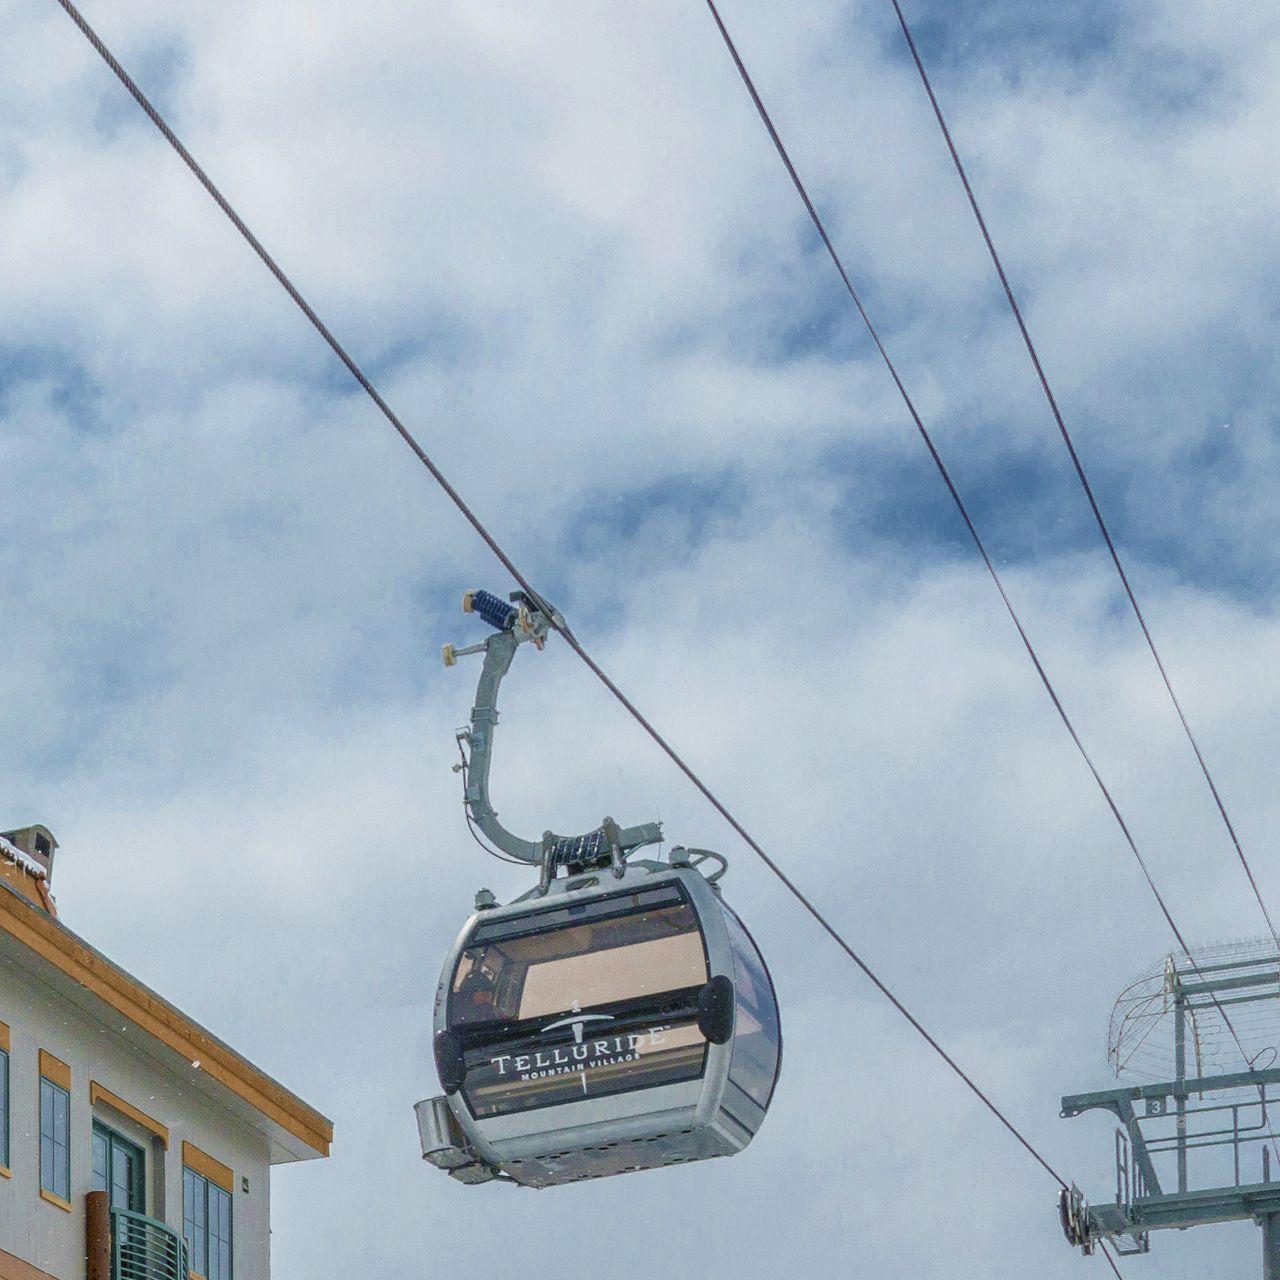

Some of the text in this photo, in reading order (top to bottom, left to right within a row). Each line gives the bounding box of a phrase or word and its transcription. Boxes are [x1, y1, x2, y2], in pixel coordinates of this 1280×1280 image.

[490, 1026, 667, 1075] TELLURIDE
[521, 1053, 640, 1081] MOUNTAIN VILLAGE
[1151, 1100, 1161, 1114] 3
